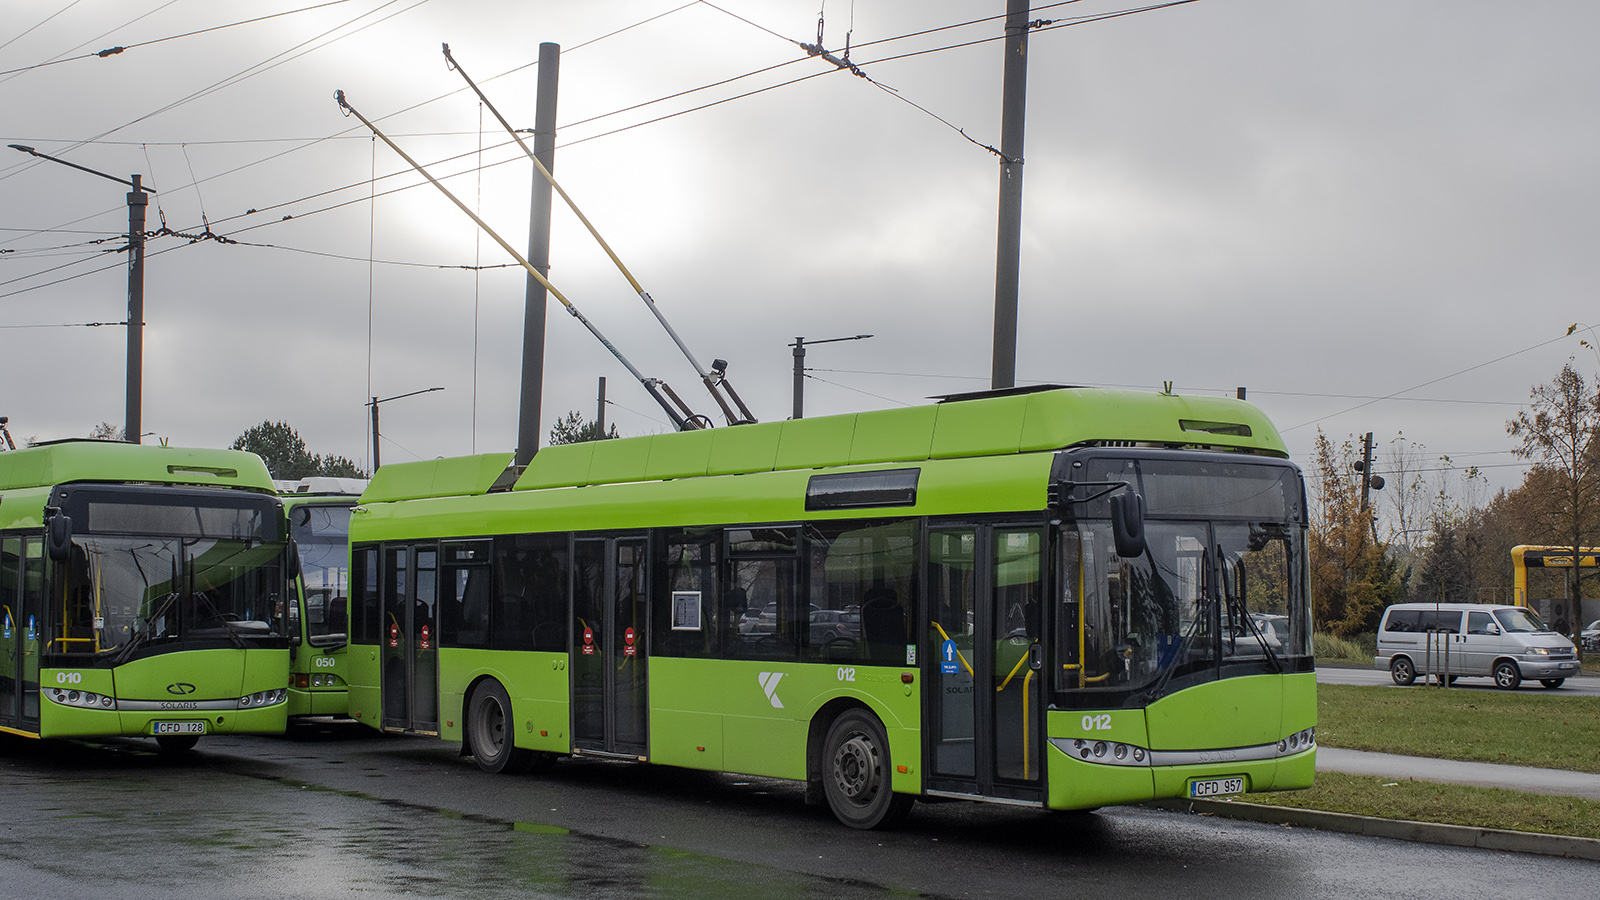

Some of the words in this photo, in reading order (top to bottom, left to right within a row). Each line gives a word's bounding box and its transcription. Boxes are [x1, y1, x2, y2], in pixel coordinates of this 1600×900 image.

[316, 657, 336, 668] 050
[57, 672, 82, 684] 010
[837, 667, 856, 682] 012
[160, 723, 181, 732] CFD
[187, 723, 203, 732] 128
[1081, 714, 1112, 731] 012
[1197, 781, 1219, 795] CFD
[1224, 779, 1242, 793] 957
